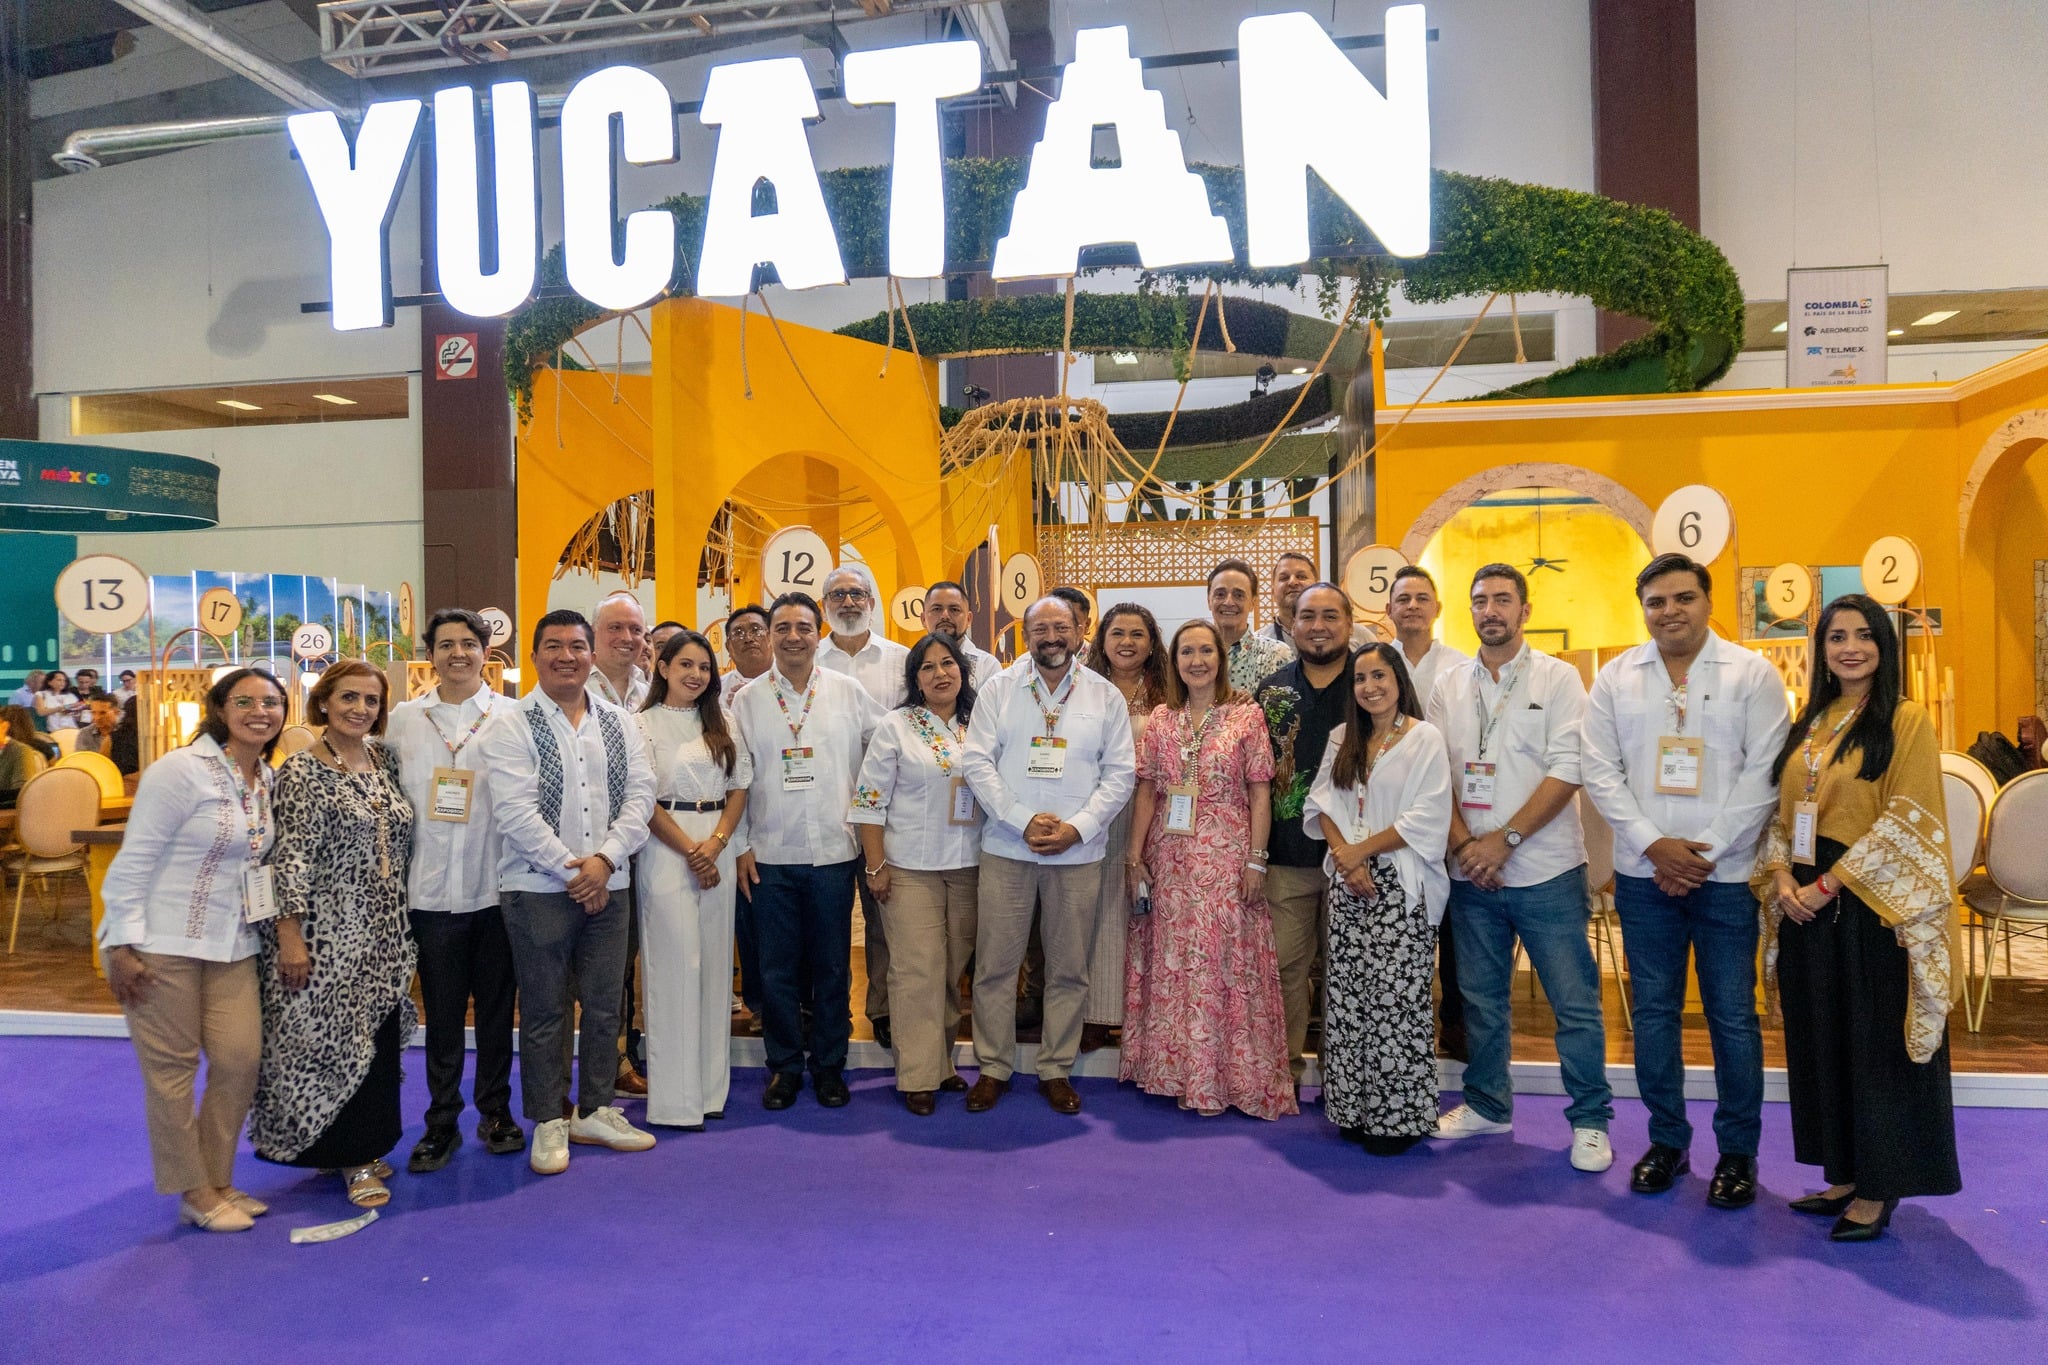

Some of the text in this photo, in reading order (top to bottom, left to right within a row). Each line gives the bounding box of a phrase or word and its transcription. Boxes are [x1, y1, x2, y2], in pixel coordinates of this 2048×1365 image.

[287, 3, 1432, 331] YUCATAN
[1805, 301, 1858, 309] COLOMBIA
[1820, 326, 1868, 334] AEROMEXICO
[1677, 510, 1702, 549] 6
[780, 549, 816, 587] 12
[1368, 565, 1389, 594] 5
[1880, 554, 1899, 585] 2
[83, 578, 124, 611] 13
[1014, 572, 1027, 600] 8
[1781, 578, 1796, 604] 3
[211, 600, 231, 622] 17
[901, 598, 924, 620] 10
[300, 633, 325, 650] 26
